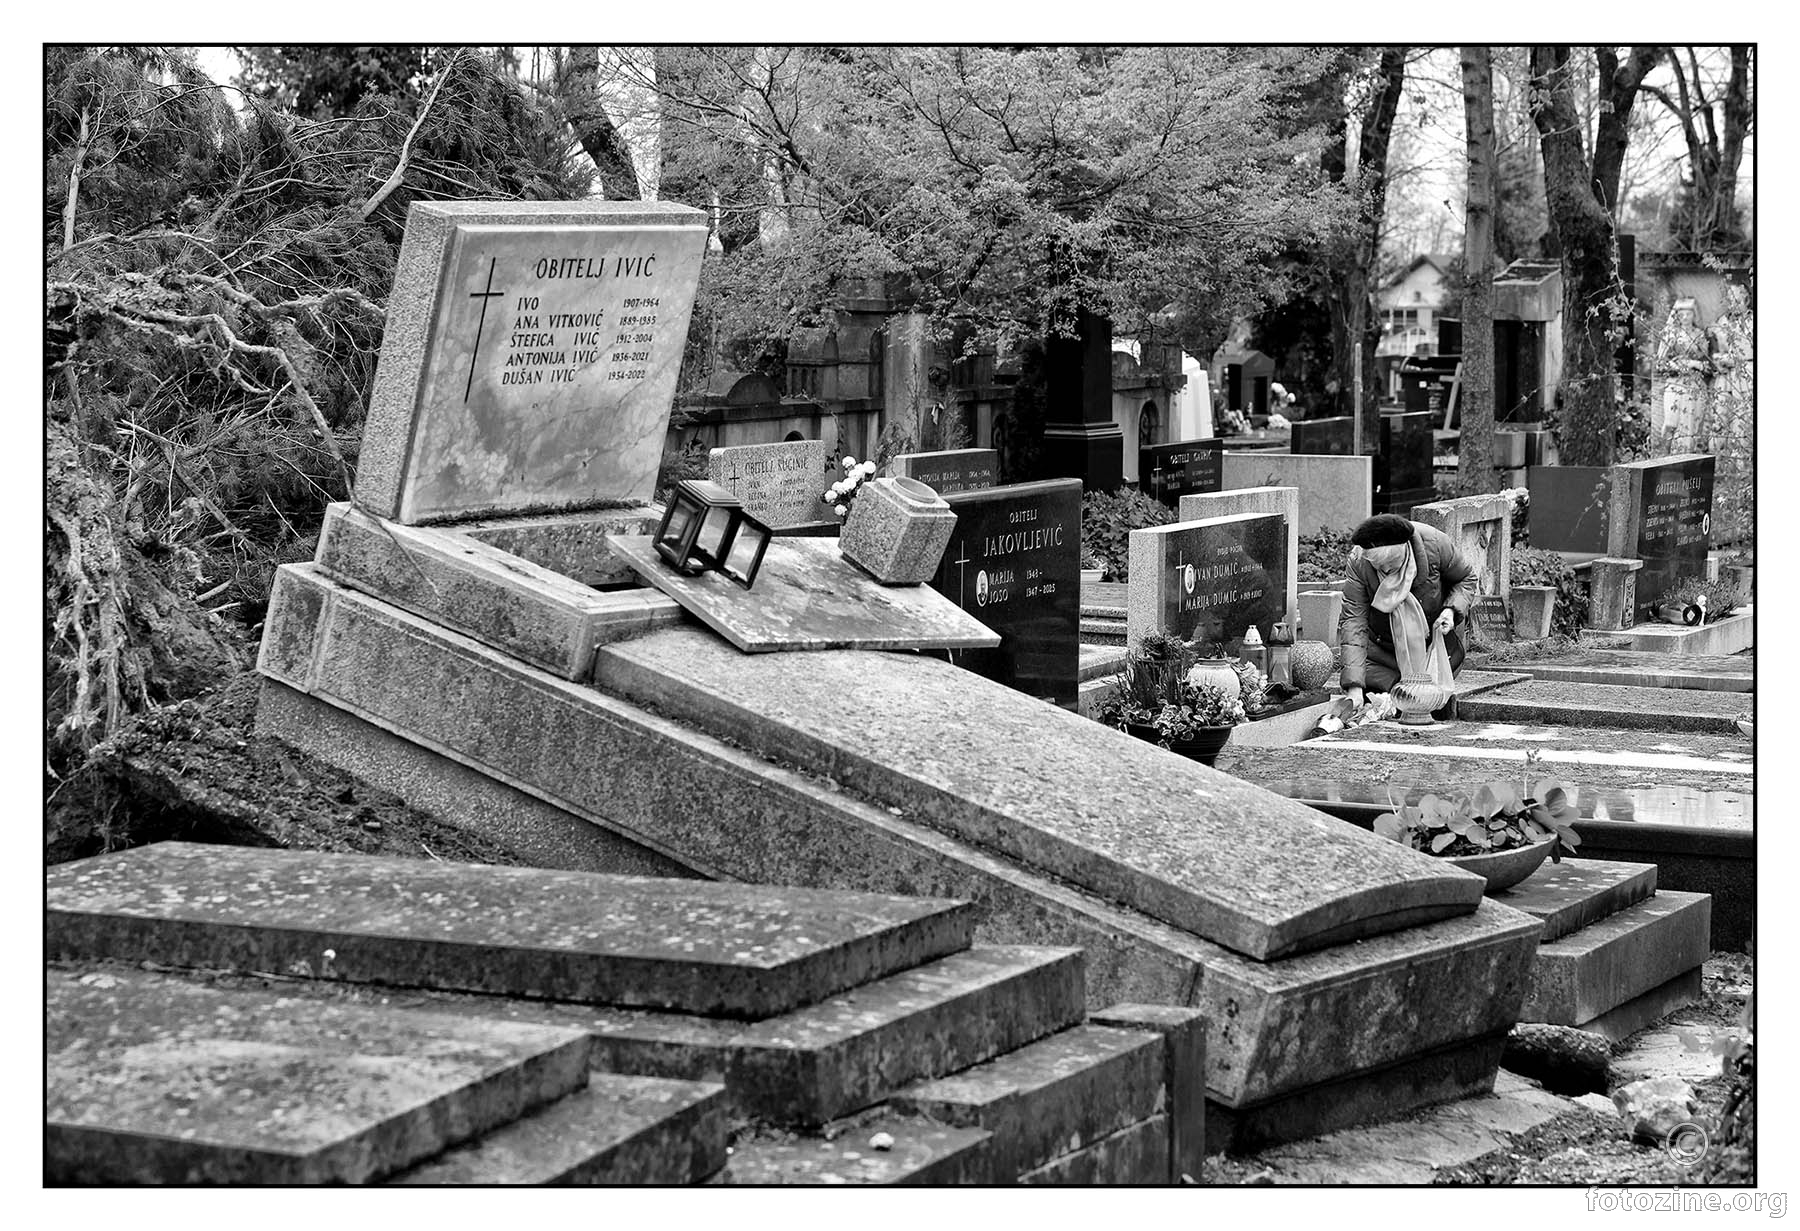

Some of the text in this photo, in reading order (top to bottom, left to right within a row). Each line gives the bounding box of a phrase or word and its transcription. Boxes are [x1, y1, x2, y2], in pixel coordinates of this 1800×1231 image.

[536, 252, 656, 279] OBITELJ IVIĆ
[517, 297, 540, 311] IVO
[513, 315, 540, 329] ANA
[549, 308, 604, 328] VITKOVIĆ
[510, 327, 653, 347] ŠTEFICA IVIĆ 1912-2004
[505, 346, 650, 366] ANTONIJA IVIĆ 1936-2021
[502, 368, 543, 384] DUŠAN
[550, 364, 576, 383] IVIĆ
[1009, 509, 1038, 523] OBITELJ
[983, 523, 1063, 557] JAKOVLJEVIĆ
[989, 570, 1015, 586] MARIJA
[1194, 567, 1211, 582] IVAN
[1213, 558, 1239, 579] DUMIĆ
[988, 588, 1009, 604] JOSO
[1185, 595, 1210, 611] MARIJA
[1213, 585, 1238, 606] DUMIĆ
